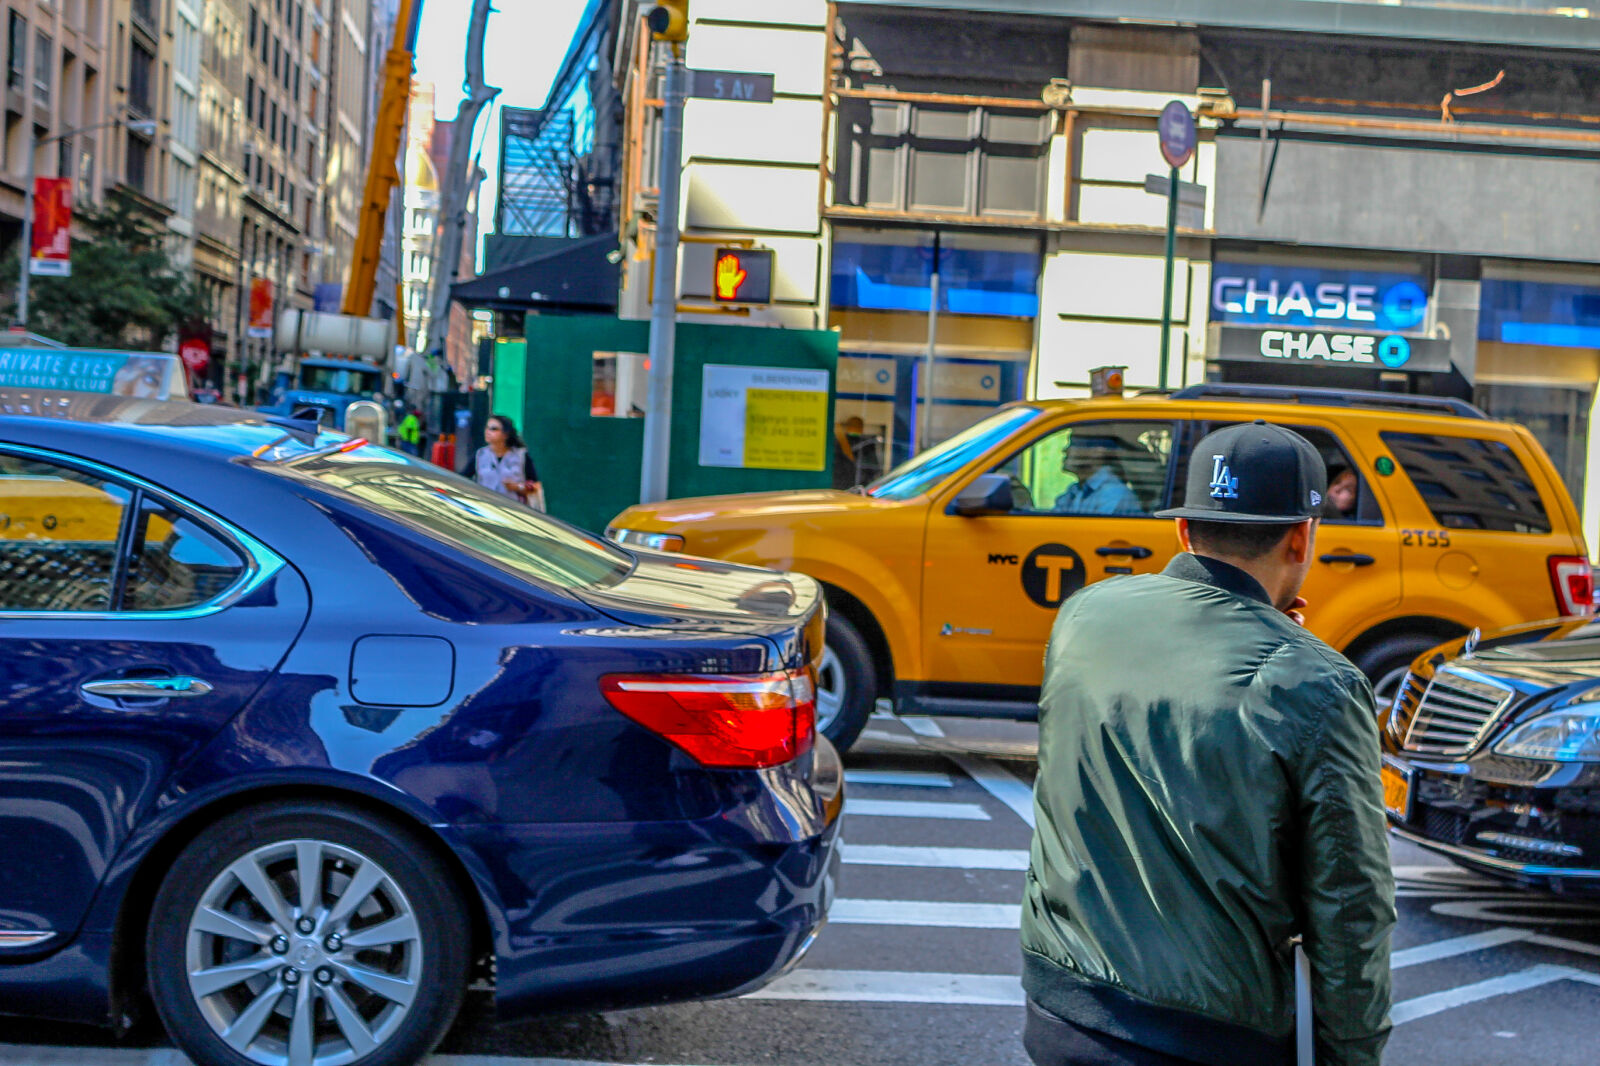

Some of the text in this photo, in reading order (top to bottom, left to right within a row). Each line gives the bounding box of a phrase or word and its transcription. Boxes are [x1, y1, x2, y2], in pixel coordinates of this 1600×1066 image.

[713, 78, 755, 100] 5 Av
[1212, 277, 1377, 321] CHASE
[1260, 330, 1375, 363] CHASE
[0, 352, 114, 377] RIVATE EYES
[74, 378, 107, 391] CLUB
[1209, 455, 1239, 498] LA
[988, 553, 1019, 565] NYC
[1035, 554, 1074, 603] T
